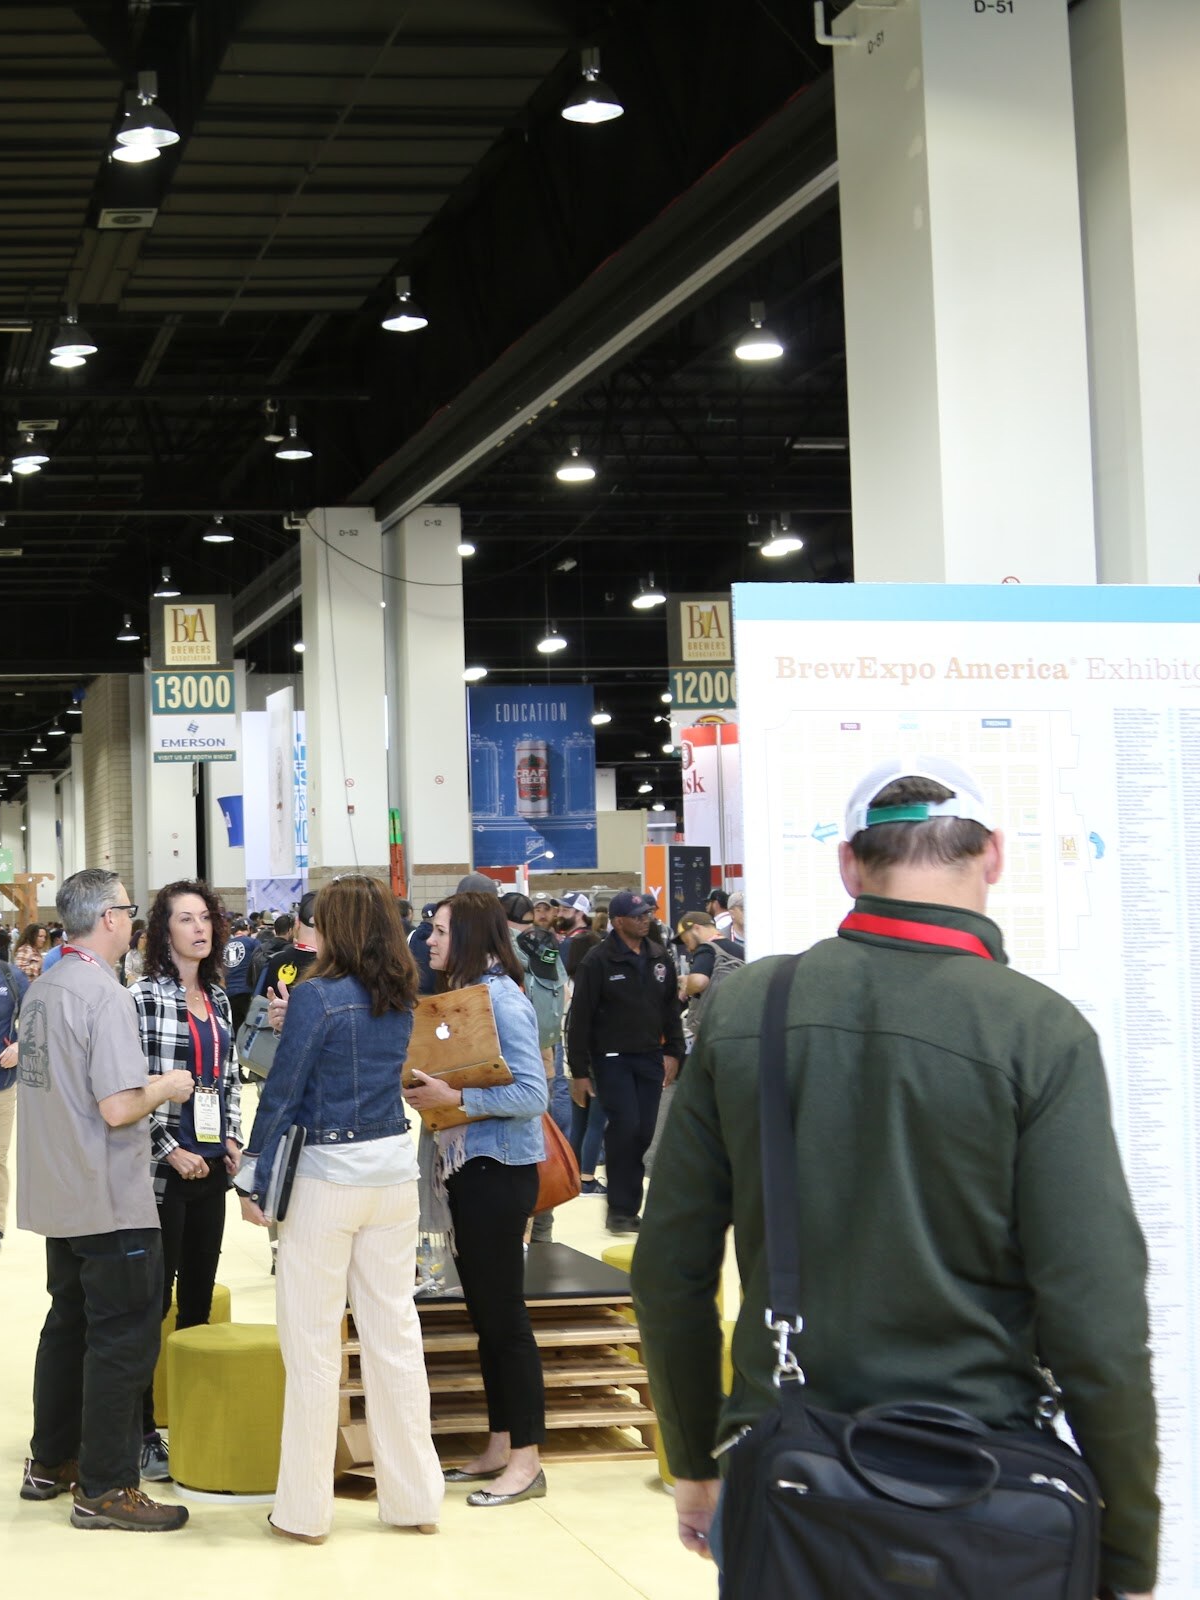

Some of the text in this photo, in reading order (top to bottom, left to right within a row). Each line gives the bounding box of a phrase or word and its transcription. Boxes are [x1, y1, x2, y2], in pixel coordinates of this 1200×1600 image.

[974, 0, 1014, 13] D-51
[171, 645, 212, 655] BREWERS
[687, 641, 727, 651] BREWERS
[775, 656, 936, 686] BrewExpo
[155, 674, 231, 709] 13000
[495, 702, 568, 723] EDUCATION
[161, 737, 226, 748] EMERSON
[520, 777, 547, 785] BEER
